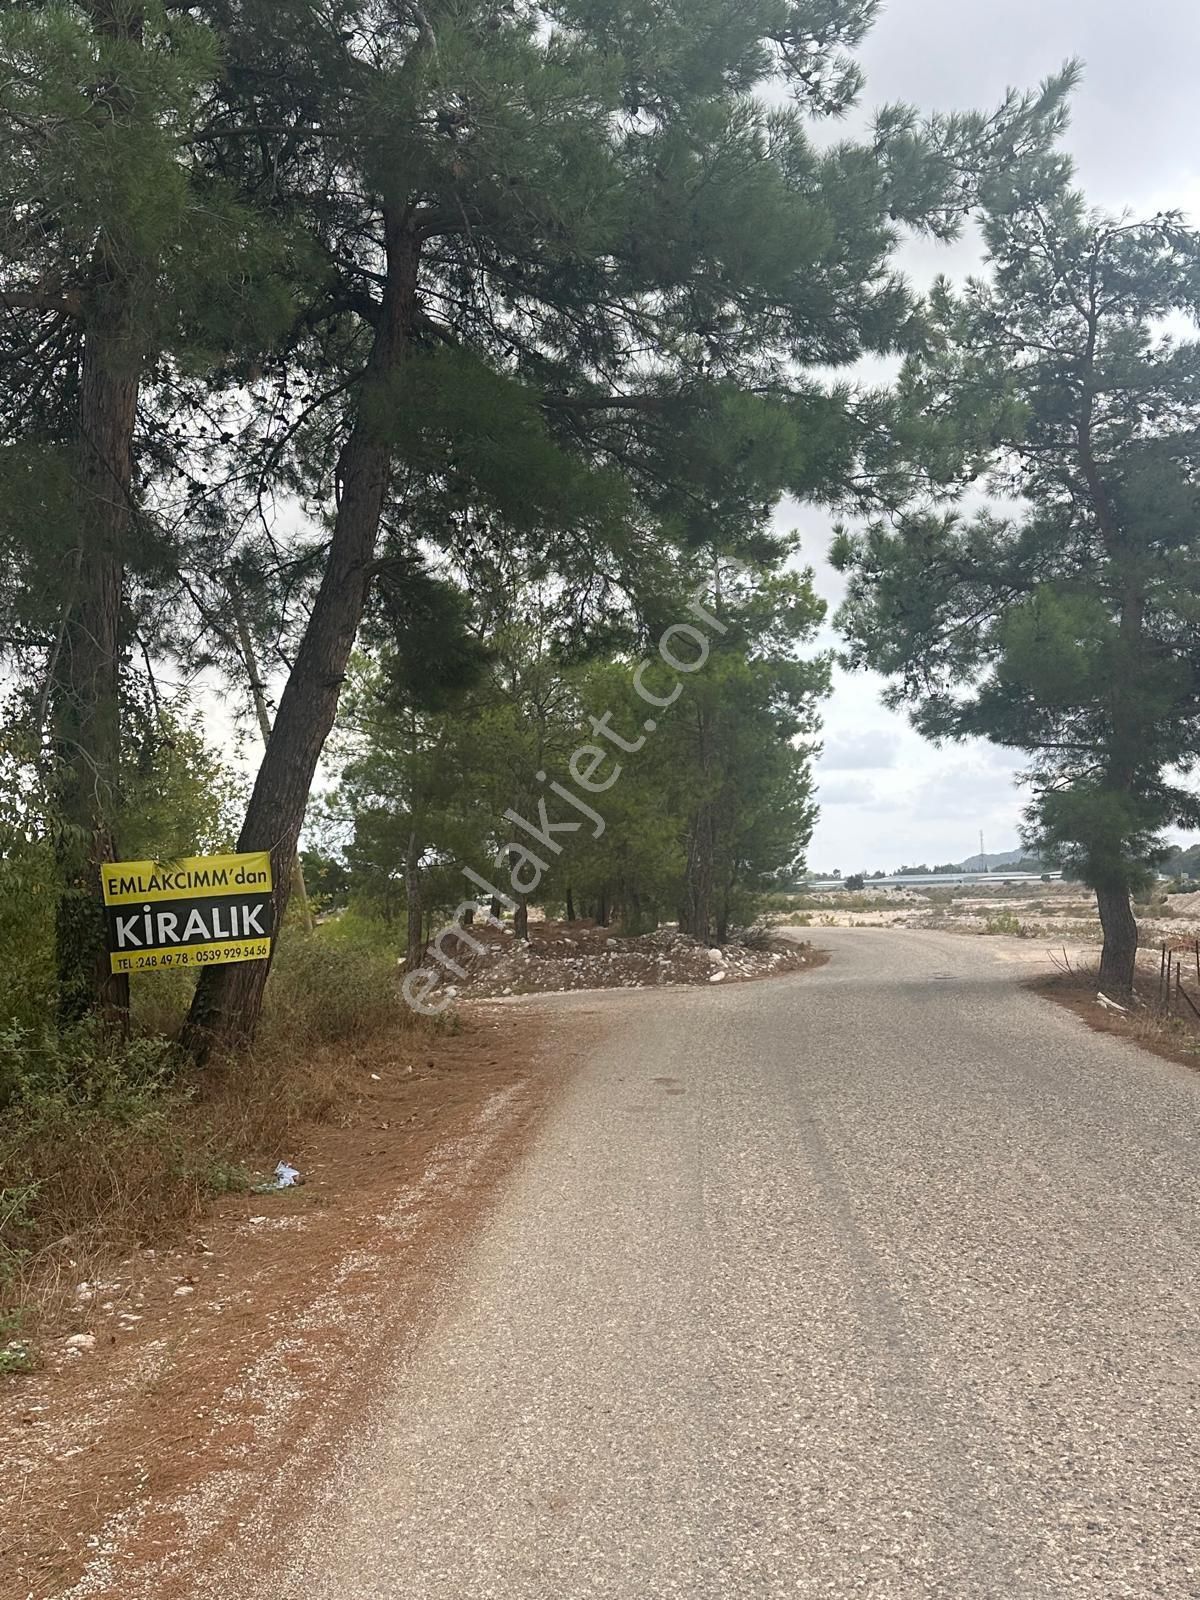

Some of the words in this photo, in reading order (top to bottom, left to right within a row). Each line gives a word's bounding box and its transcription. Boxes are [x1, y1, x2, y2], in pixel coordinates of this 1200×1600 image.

[108, 868, 267, 896] EMLAKCIMM'dan
[116, 904, 265, 948] KİRALIK
[160, 954, 173, 966] 49
[175, 952, 188, 964] 78
[196, 948, 221, 961] 0539
[223, 947, 241, 959] 929
[244, 946, 255, 957] 54
[256, 946, 267, 955] 56
